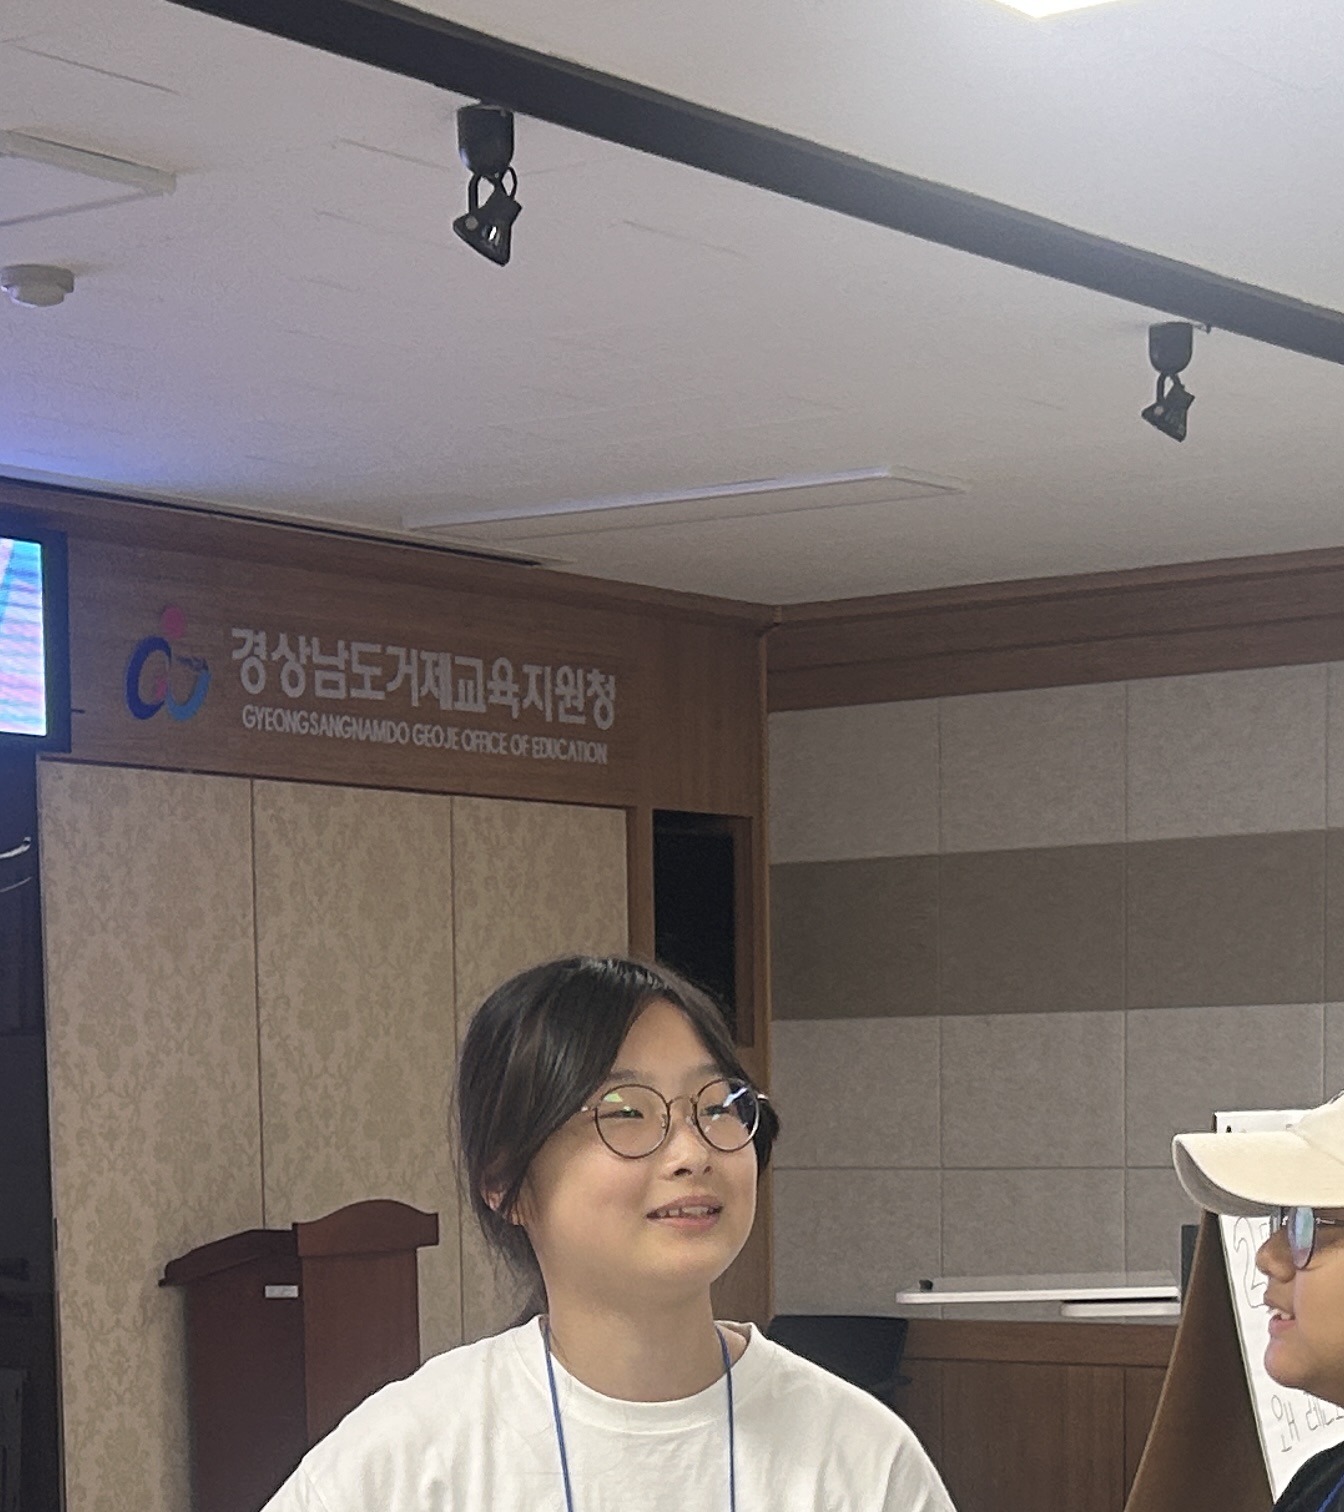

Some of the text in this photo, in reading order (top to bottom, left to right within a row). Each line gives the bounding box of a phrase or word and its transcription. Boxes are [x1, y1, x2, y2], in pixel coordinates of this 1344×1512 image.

[231, 627, 617, 731] 경상남도거제교육지원청
[241, 704, 608, 766] GYEONGSANGNAMDO GEOJE OFFICE OF EDUCATION
